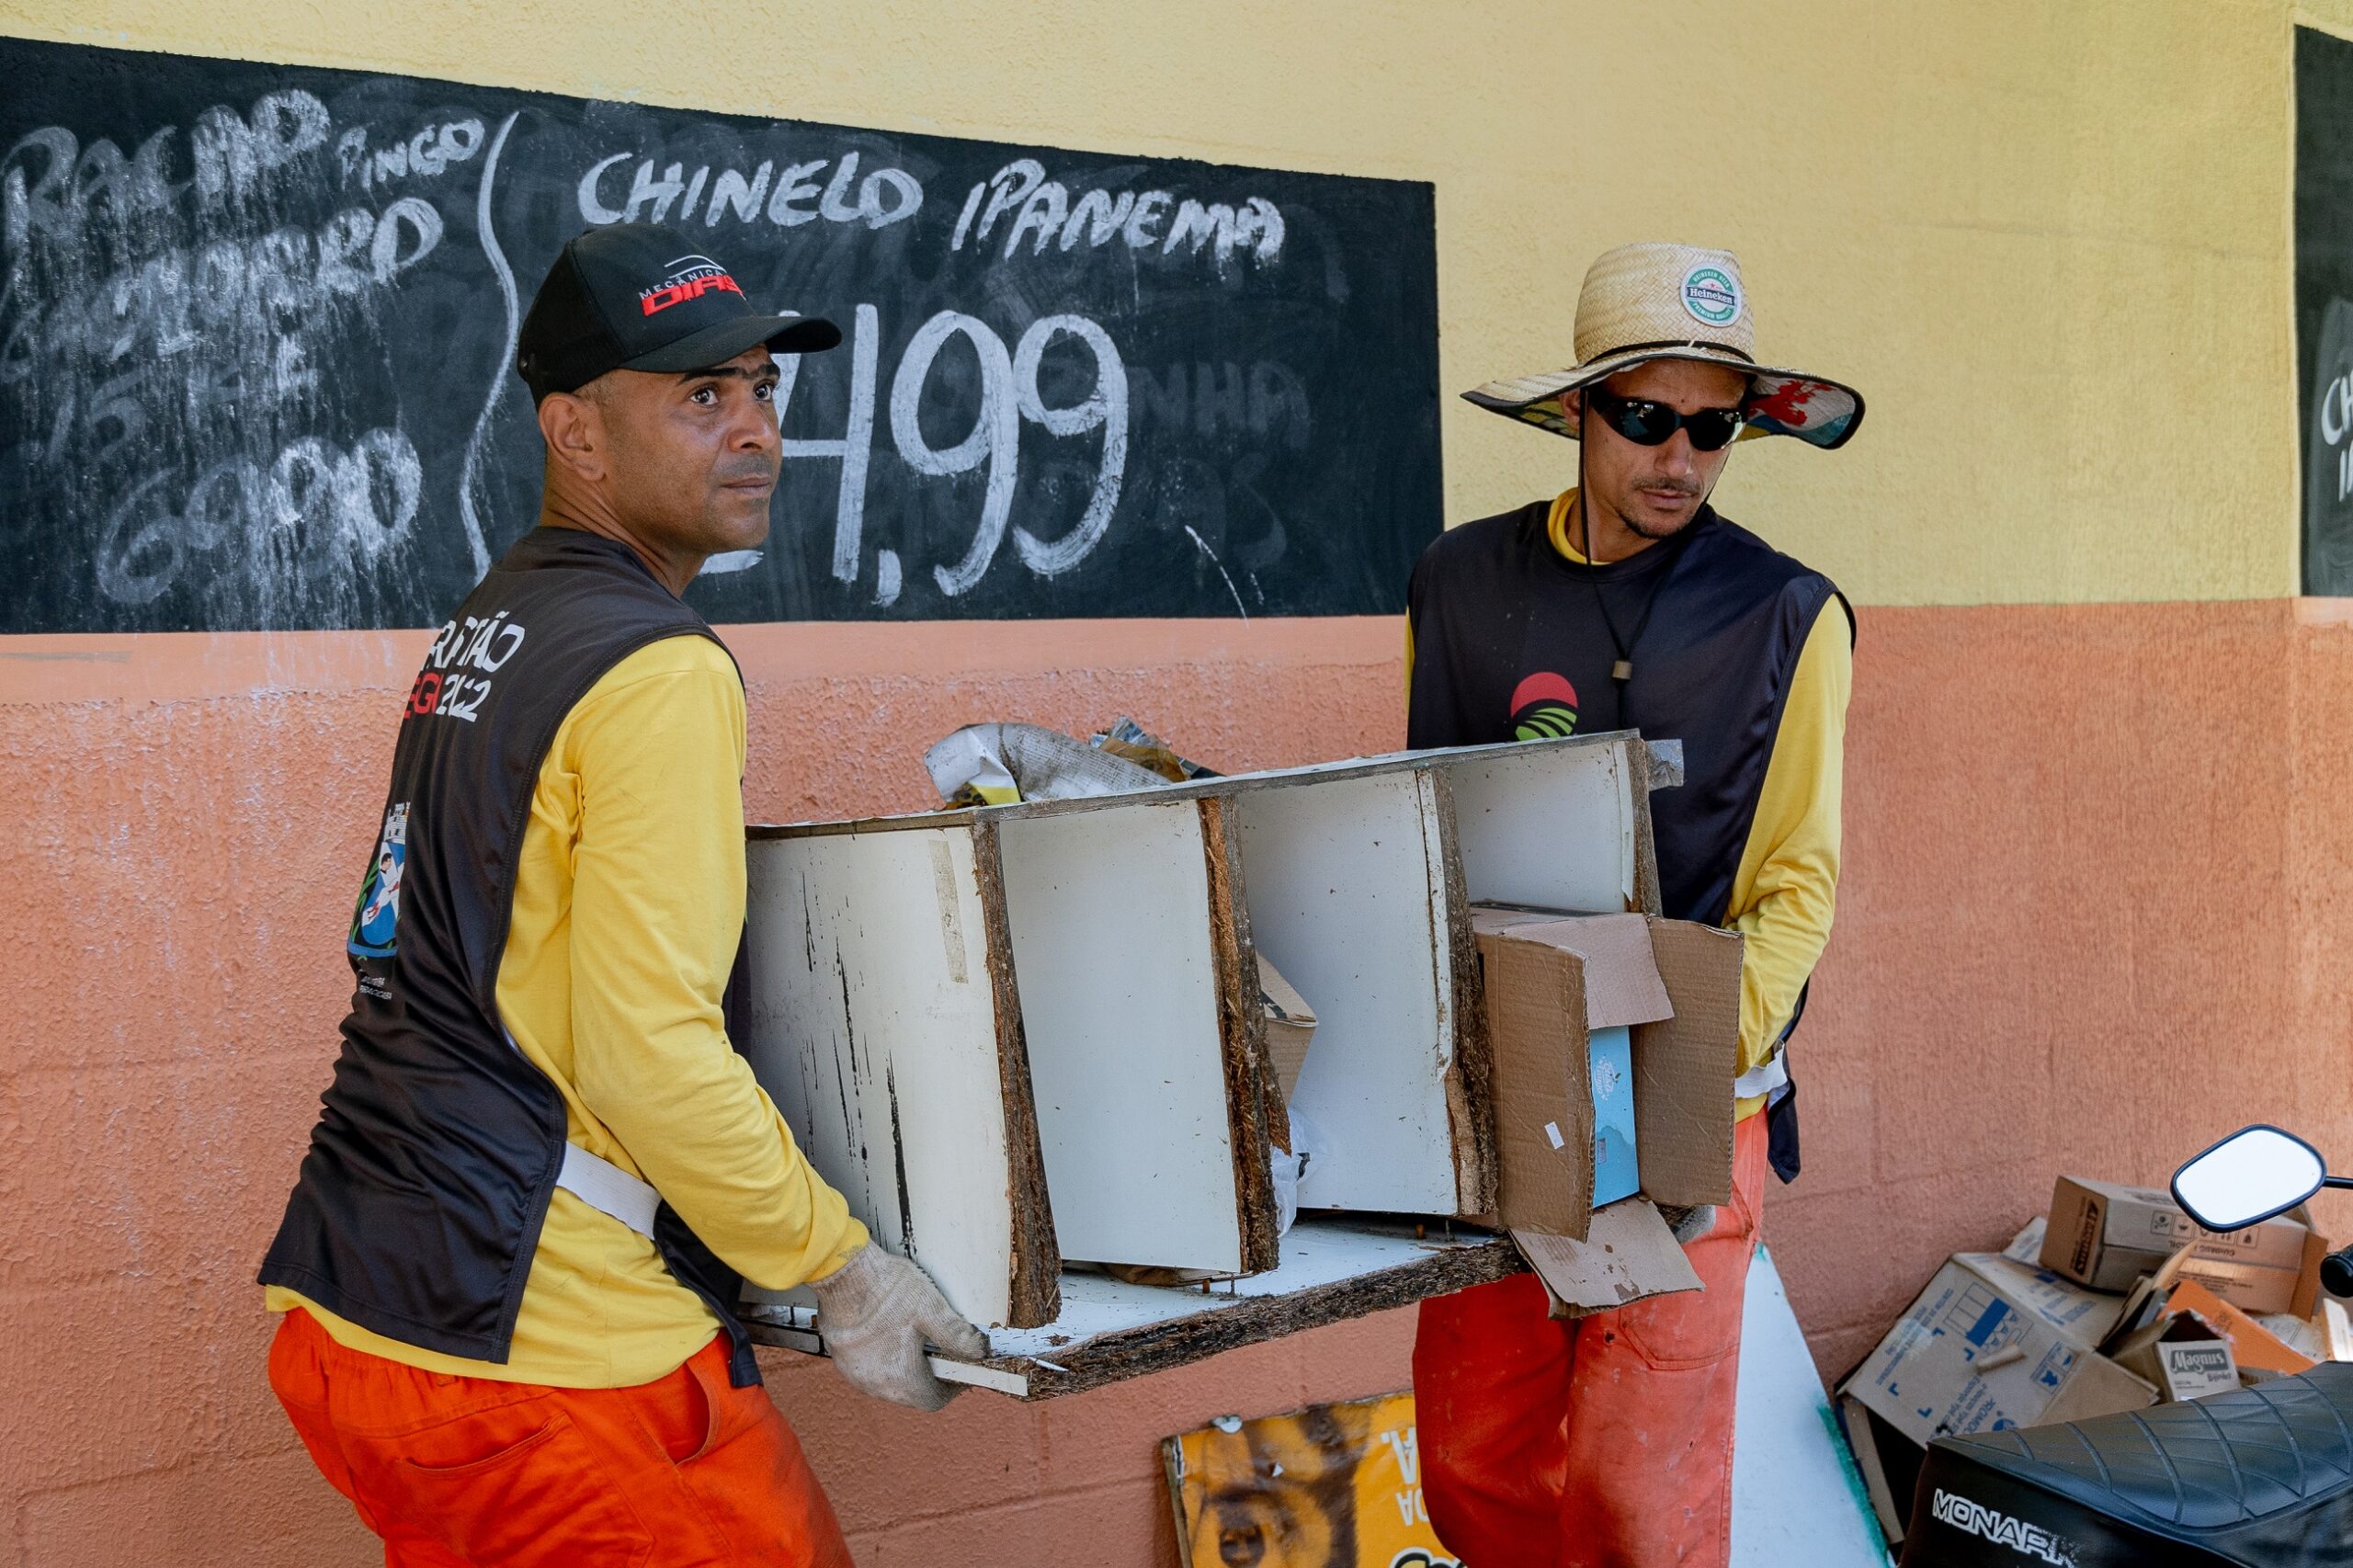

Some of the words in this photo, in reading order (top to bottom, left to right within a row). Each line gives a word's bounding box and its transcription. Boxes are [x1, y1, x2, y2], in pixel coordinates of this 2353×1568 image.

[578, 151, 924, 229] CHINELO
[952, 157, 1286, 268] IPANEMA
[1689, 288, 1733, 305] Heineken
[699, 303, 1128, 608] 4,99
[2172, 1350, 2224, 1373] Magnus
